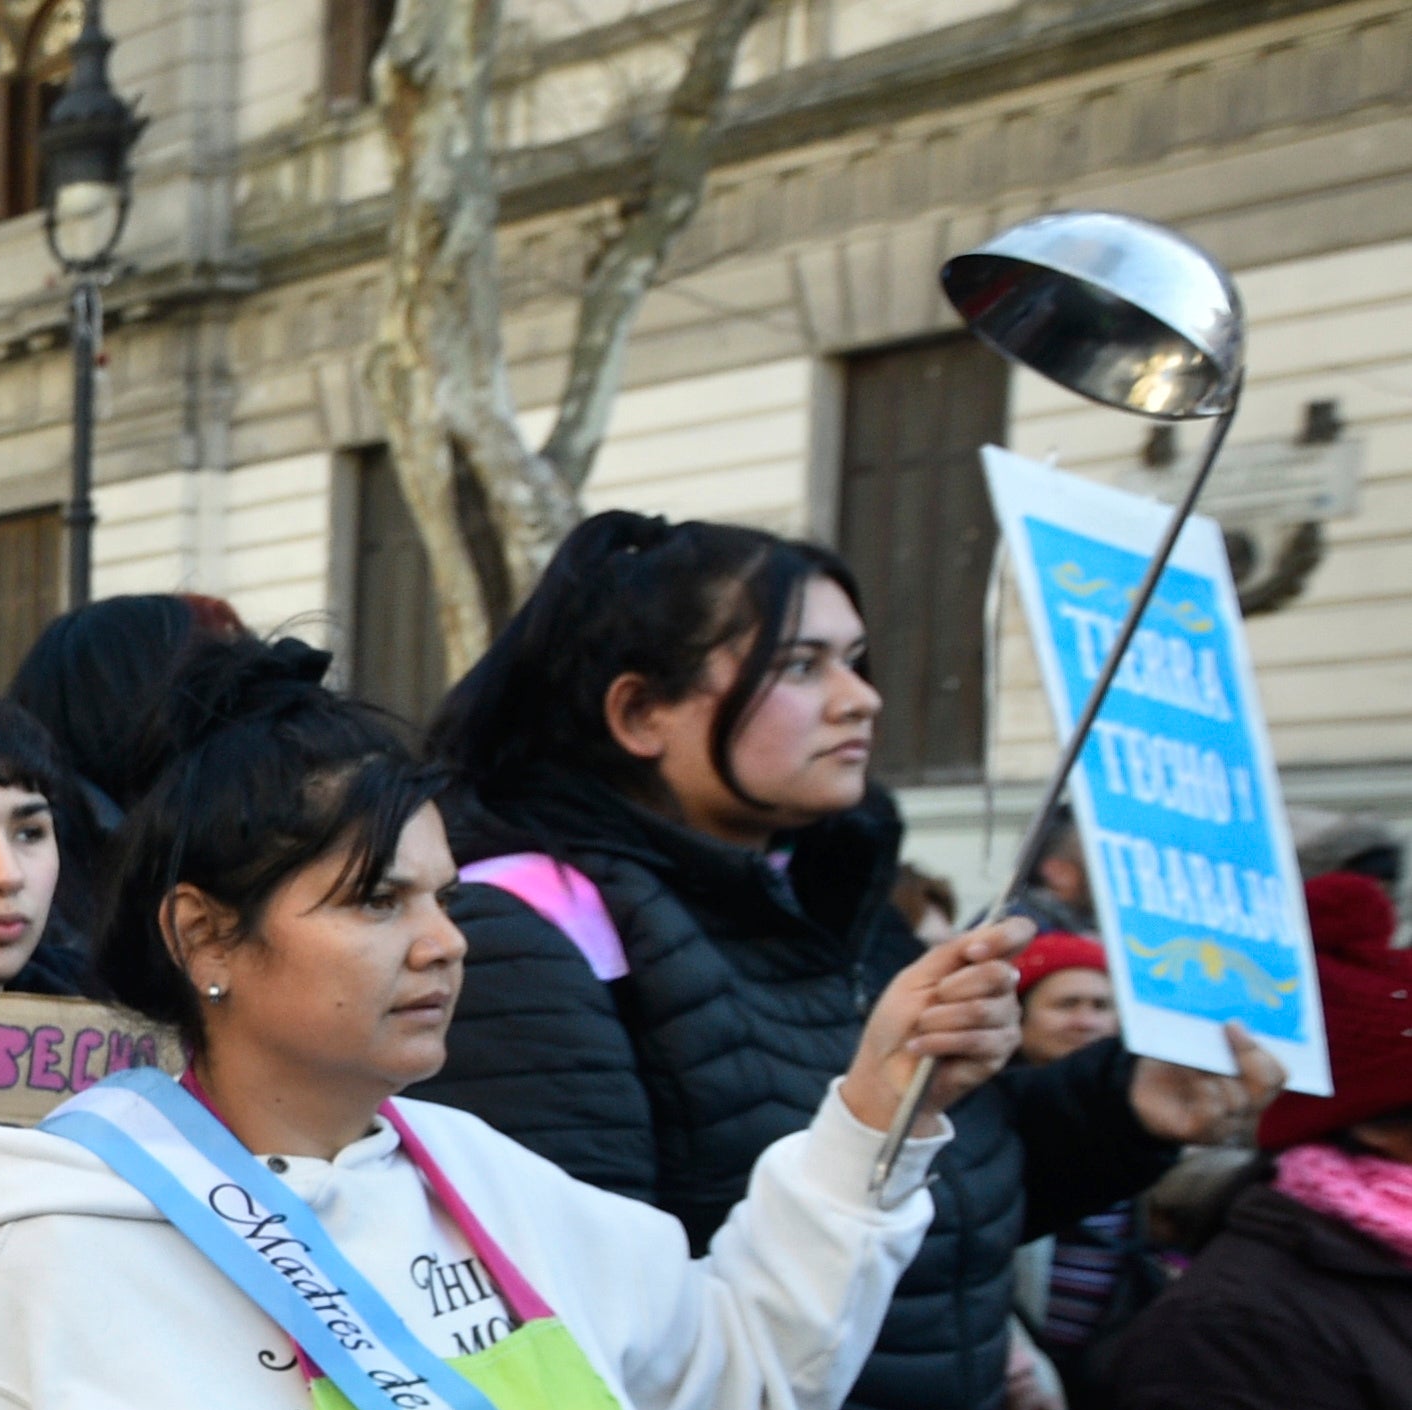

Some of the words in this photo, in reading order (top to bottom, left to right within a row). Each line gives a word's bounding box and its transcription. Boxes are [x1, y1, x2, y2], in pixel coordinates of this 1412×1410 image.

[1060, 604, 1233, 722] TIERRA
[1092, 719, 1233, 825] TECHO
[1095, 827, 1299, 951] TRABAJO
[208, 1182, 375, 1351] Madres
[367, 1368, 430, 1410] de
